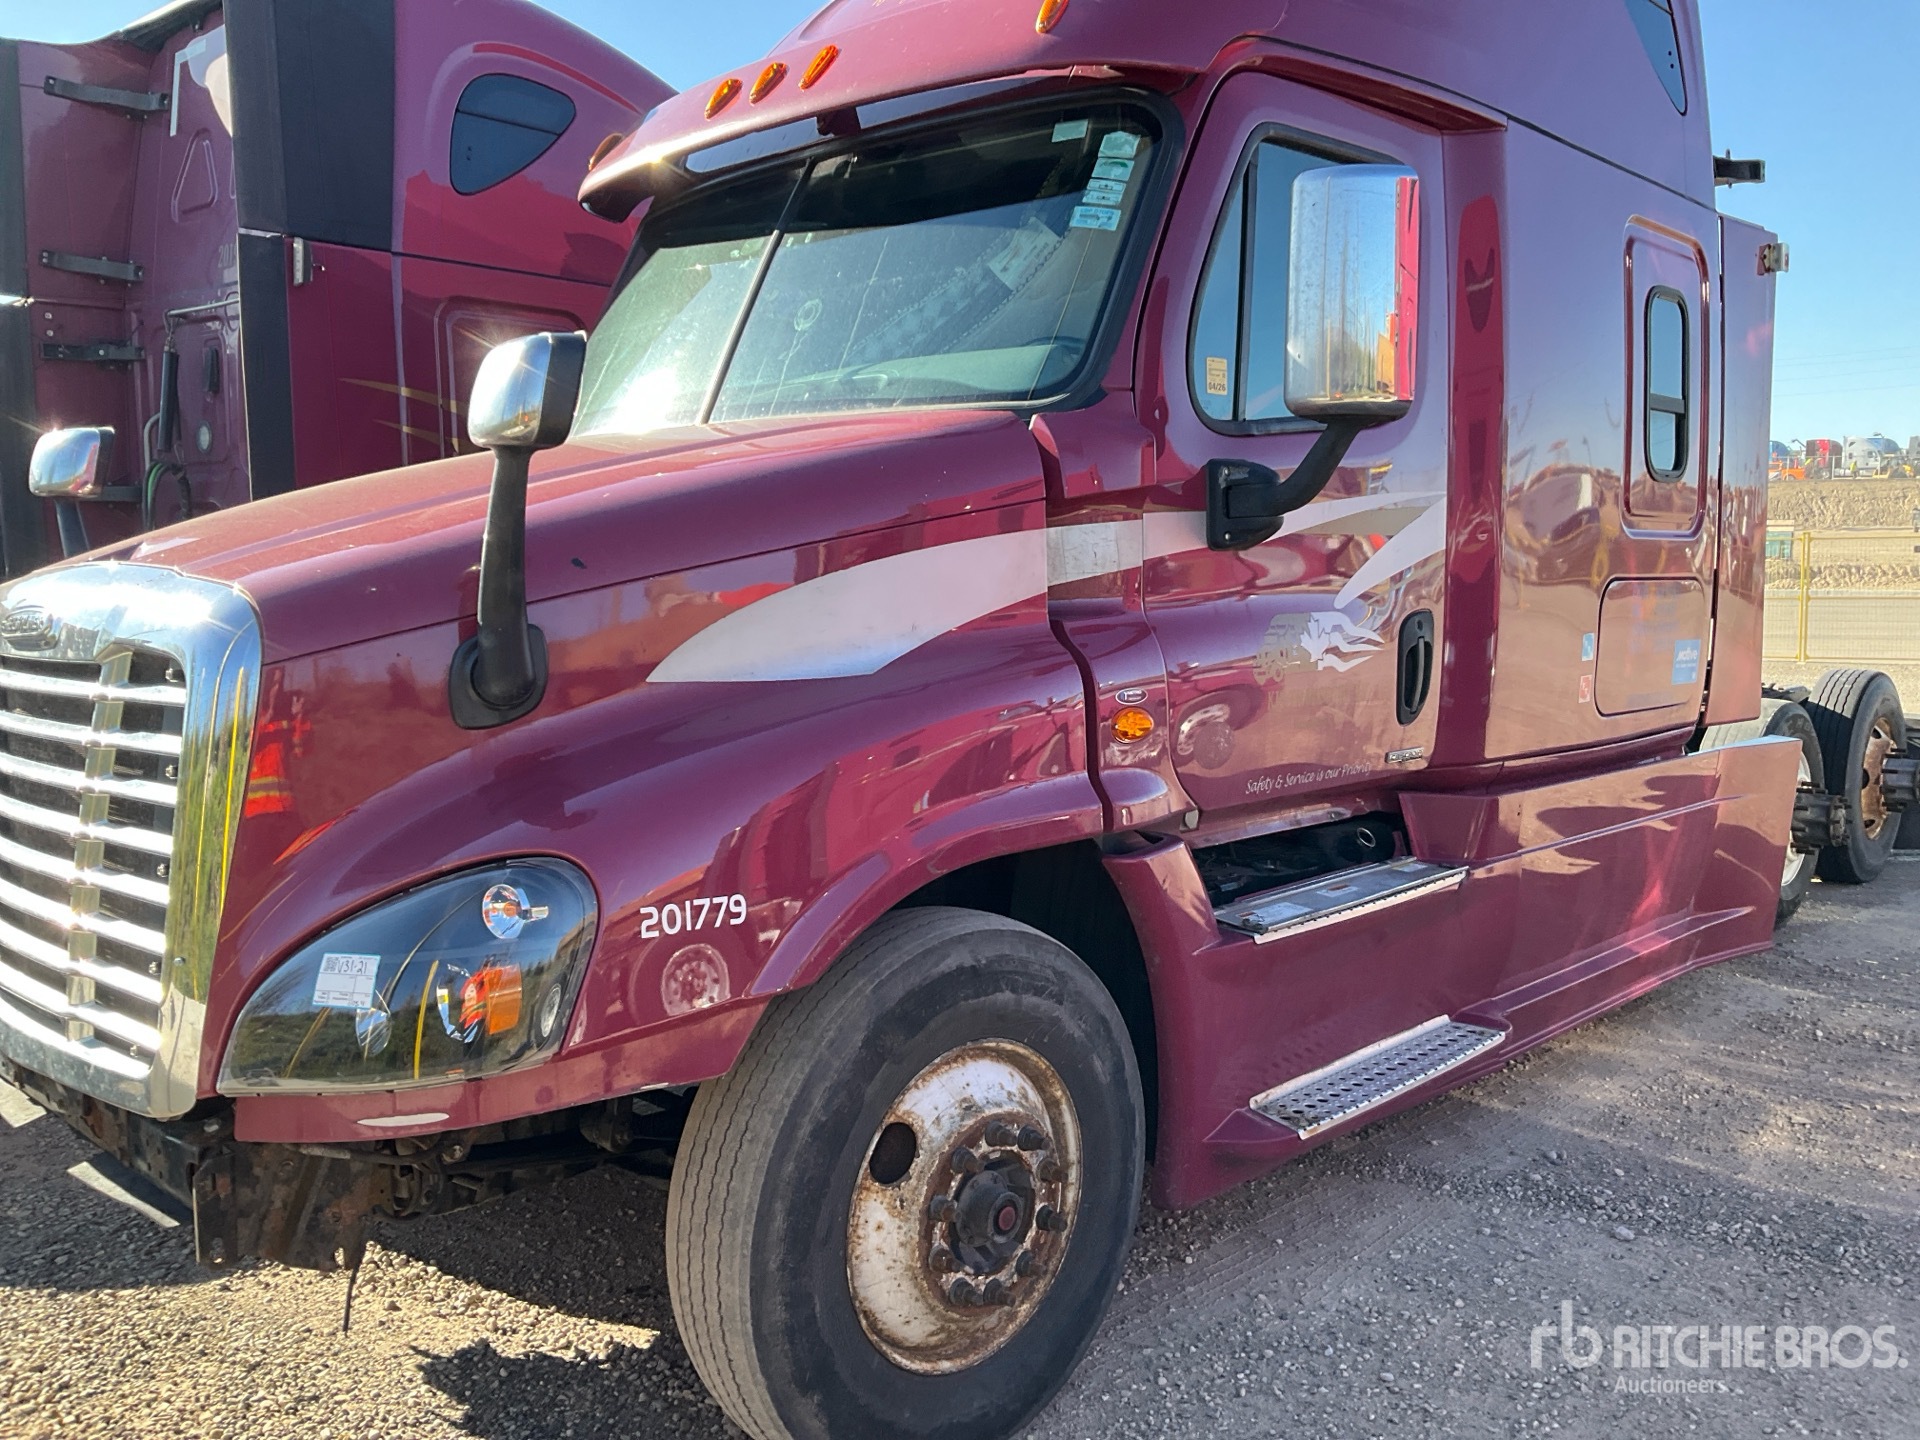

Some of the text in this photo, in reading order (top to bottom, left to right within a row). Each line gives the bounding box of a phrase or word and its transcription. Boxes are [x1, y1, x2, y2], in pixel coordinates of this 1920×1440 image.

[1245, 775, 1273, 794] Safety
[1275, 774, 1283, 789] &
[1284, 767, 1315, 787] Service
[1316, 768, 1324, 781] is
[1325, 767, 1341, 779] our
[640, 894, 747, 939] 201779
